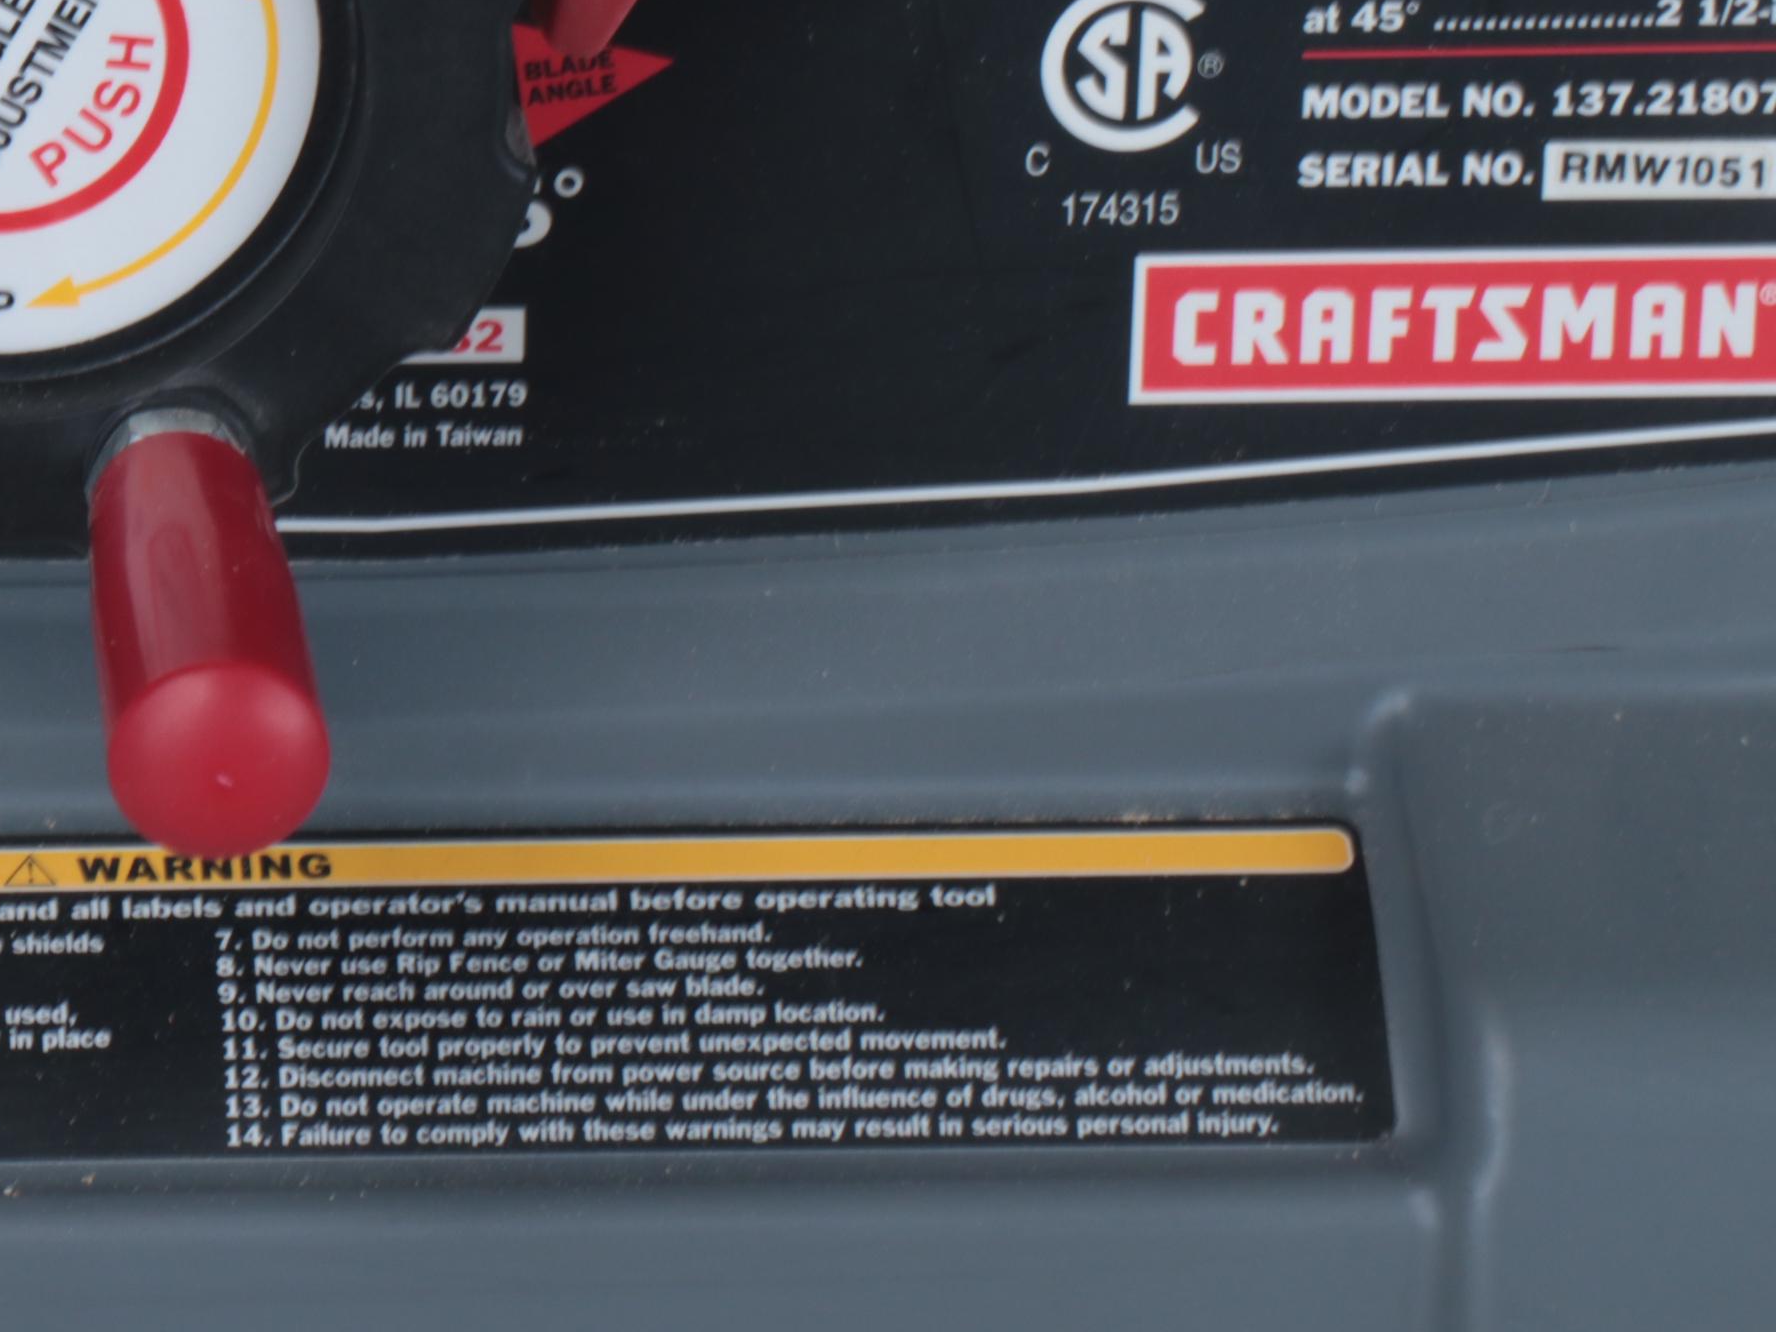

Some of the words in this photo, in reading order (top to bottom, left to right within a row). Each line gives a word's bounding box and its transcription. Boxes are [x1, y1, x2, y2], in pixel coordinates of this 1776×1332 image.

[1304, 3, 1340, 33] at
[528, 75, 617, 107] ANGLE
[1302, 85, 1449, 119] MODEL
[1463, 83, 1534, 117] NO.
[29, 32, 155, 187] PUSH
[1196, 141, 1241, 173] US
[1298, 154, 1448, 187] SERIAL
[1463, 152, 1533, 185] NO.
[1561, 152, 1763, 187] RMW1051
[1063, 193, 1179, 225] 174315
[395, 384, 420, 408] IL
[431, 382, 527, 408] 60179
[325, 424, 394, 447] Made
[404, 425, 427, 447] in
[436, 423, 522, 446] Taiwan
[77, 853, 331, 882] WARNING
[70, 901, 111, 920] all
[121, 899, 223, 919] labels
[234, 898, 297, 917] and
[495, 892, 619, 913] manual
[629, 890, 743, 910] before
[754, 887, 919, 912] operating
[929, 886, 997, 905] tool
[11, 935, 105, 955] shields
[251, 931, 290, 949] Do
[296, 930, 340, 949] not
[348, 929, 455, 952] perform
[462, 932, 508, 951] any
[515, 926, 641, 950] operation
[255, 983, 334, 1001] Never
[342, 982, 416, 1001] reach
[423, 981, 515, 1000] around
[521, 985, 551, 999] or
[558, 984, 618, 999] over
[625, 984, 678, 998] saw
[280, 1125, 372, 1143] Failure
[379, 1124, 409, 1142] to
[415, 1123, 510, 1146] comply
[517, 1123, 576, 1141] with
[582, 1122, 657, 1140] these
[664, 1120, 784, 1144] warnings
[791, 1124, 847, 1142] may
[853, 1119, 932, 1138] result
[938, 1119, 964, 1137] in
[970, 1118, 1069, 1137] serious
[1076, 1116, 1191, 1140] personal
